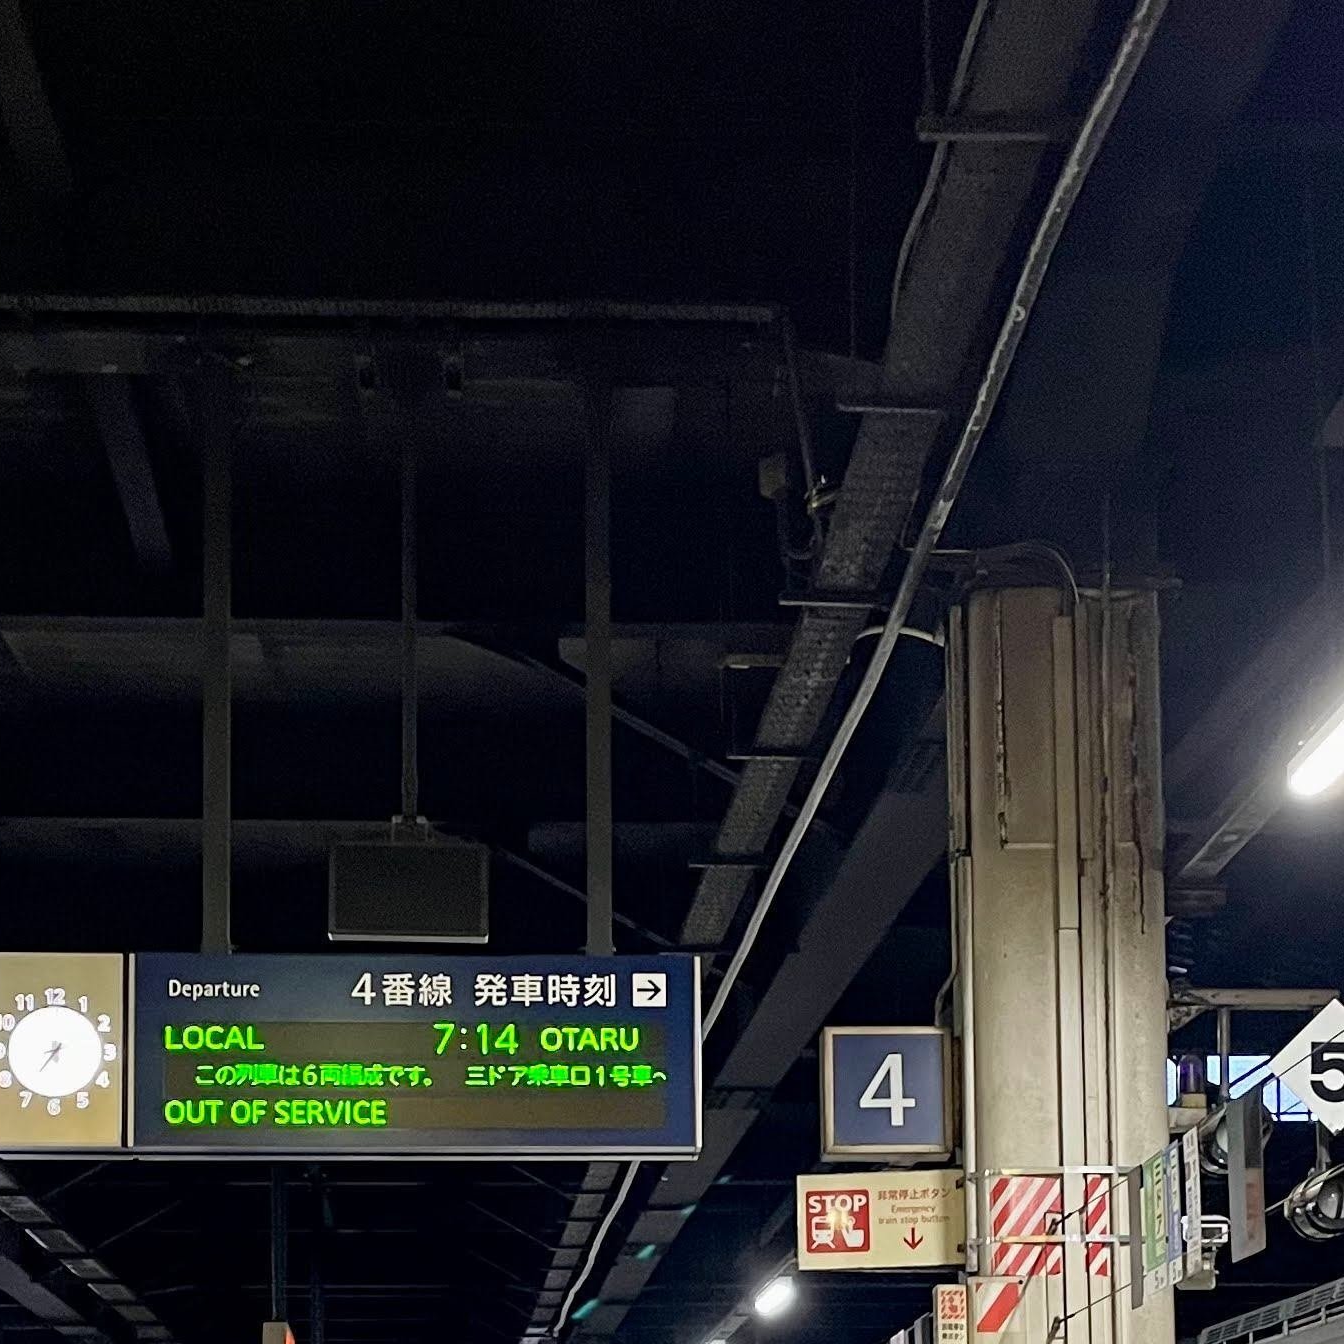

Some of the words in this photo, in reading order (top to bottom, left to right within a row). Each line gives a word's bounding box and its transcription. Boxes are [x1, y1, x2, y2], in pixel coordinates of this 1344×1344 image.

[44, 987, 66, 1005] 12
[168, 979, 260, 1001] Departure
[351, 972, 453, 1006] 4番線
[473, 973, 617, 1007] 発車時刻
[14, 993, 35, 1011] 11
[78, 995, 88, 1013] 1
[97, 1014, 111, 1033] 2
[164, 1025, 265, 1051] LOCAL
[432, 1022, 519, 1056] 7:14
[540, 1026, 639, 1052] OTARU
[103, 1043, 117, 1061] 3
[95, 1071, 110, 1088] 4
[859, 1053, 916, 1127] 4
[19, 1091, 33, 1108] 7
[46, 1098, 61, 1116] 6
[76, 1091, 90, 1109] 5
[164, 1098, 223, 1125] OUT
[230, 1098, 268, 1125] OF
[274, 1098, 387, 1126] SERVICE
[808, 1194, 868, 1214] STOP
